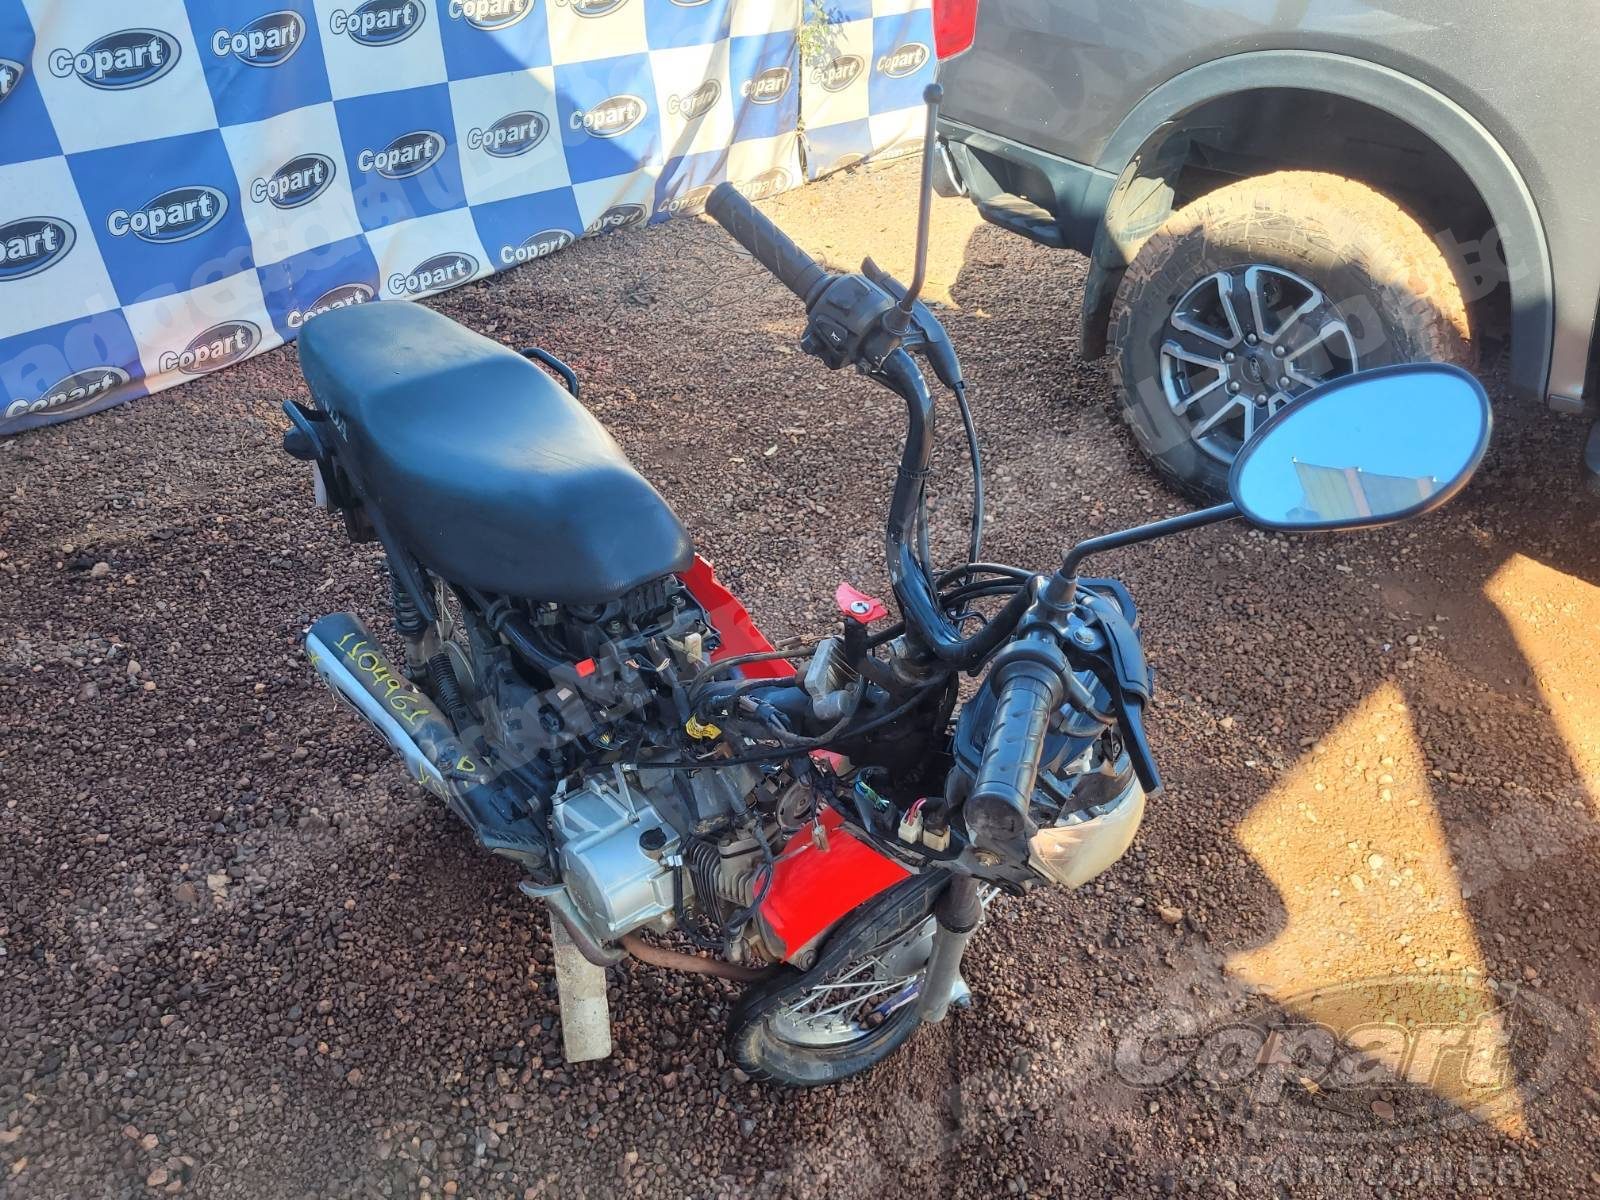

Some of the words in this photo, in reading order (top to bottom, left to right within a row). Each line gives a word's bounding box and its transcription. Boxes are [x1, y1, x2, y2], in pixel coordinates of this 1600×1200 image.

[330, 4, 413, 35] Copart
[212, 20, 298, 57] Copart
[48, 35, 163, 80] Copart
[810, 61, 858, 86] Copart
[876, 49, 923, 73] Copart
[569, 100, 636, 130] Copart
[467, 120, 538, 150] Copart
[357, 139, 434, 173] Copart
[250, 160, 325, 203] Copart
[107, 191, 213, 237] Copart
[500, 233, 567, 264] Copart
[388, 257, 467, 295] Copart
[158, 326, 248, 373] Copart
